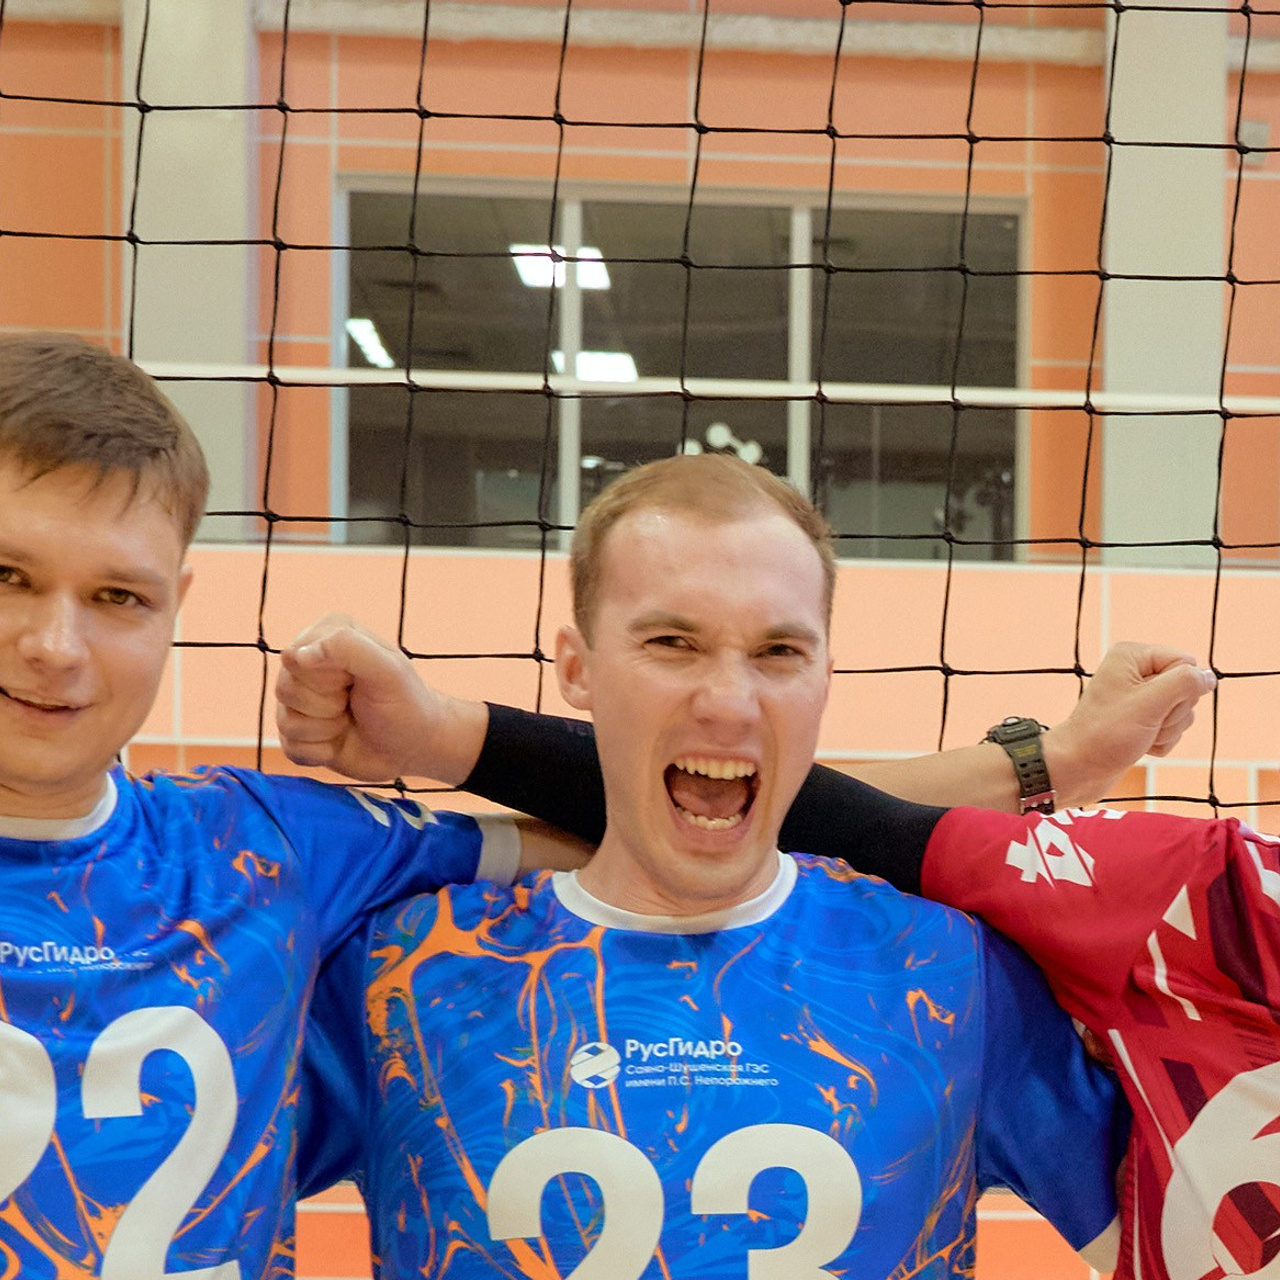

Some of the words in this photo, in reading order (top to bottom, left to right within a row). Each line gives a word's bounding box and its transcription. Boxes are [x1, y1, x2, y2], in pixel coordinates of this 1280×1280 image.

[0, 941, 115, 967] РусГидро
[625, 1037, 743, 1061] РусГидро
[625, 1061, 744, 1075] Саяно-Шушенская
[745, 1062, 770, 1074] ГЭС
